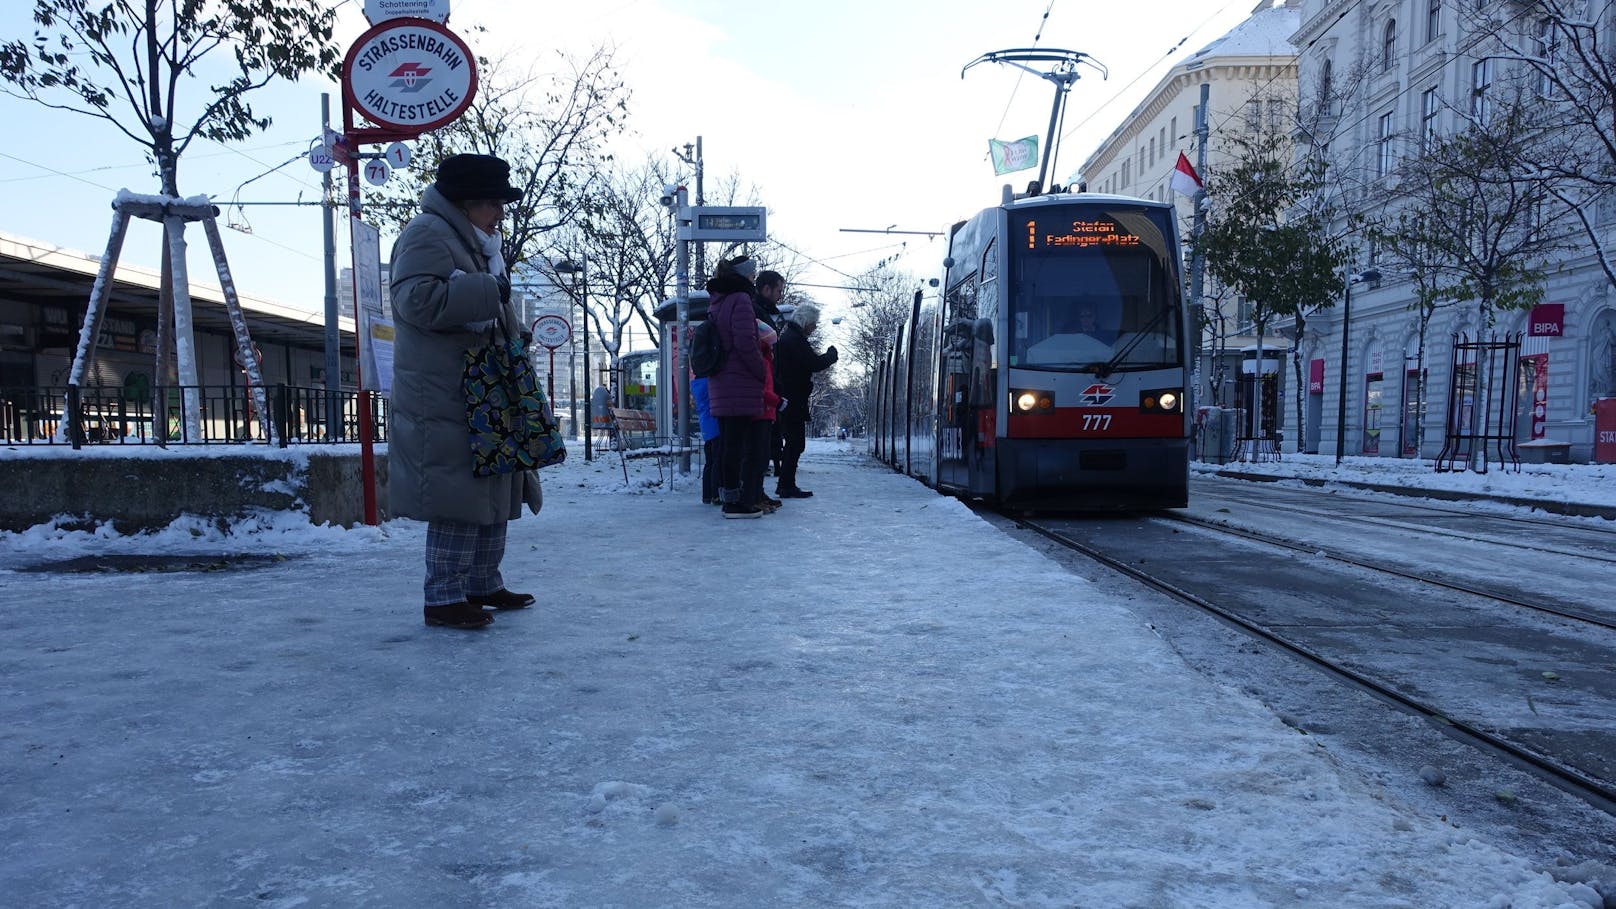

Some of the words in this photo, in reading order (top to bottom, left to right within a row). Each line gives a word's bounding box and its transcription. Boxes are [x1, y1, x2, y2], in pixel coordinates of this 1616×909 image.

[379, 0, 428, 8] Schottenring
[358, 34, 462, 71] STRASSENBAHN
[364, 88, 459, 120] HALTESTELLE
[395, 148, 403, 162] 1
[368, 166, 385, 180] 71
[1072, 221, 1115, 232] Stefan
[1027, 220, 1036, 249] 1
[1046, 234, 1140, 247] Fadinger-Platz
[1534, 322, 1560, 334] BIPA
[1082, 414, 1112, 431] 777
